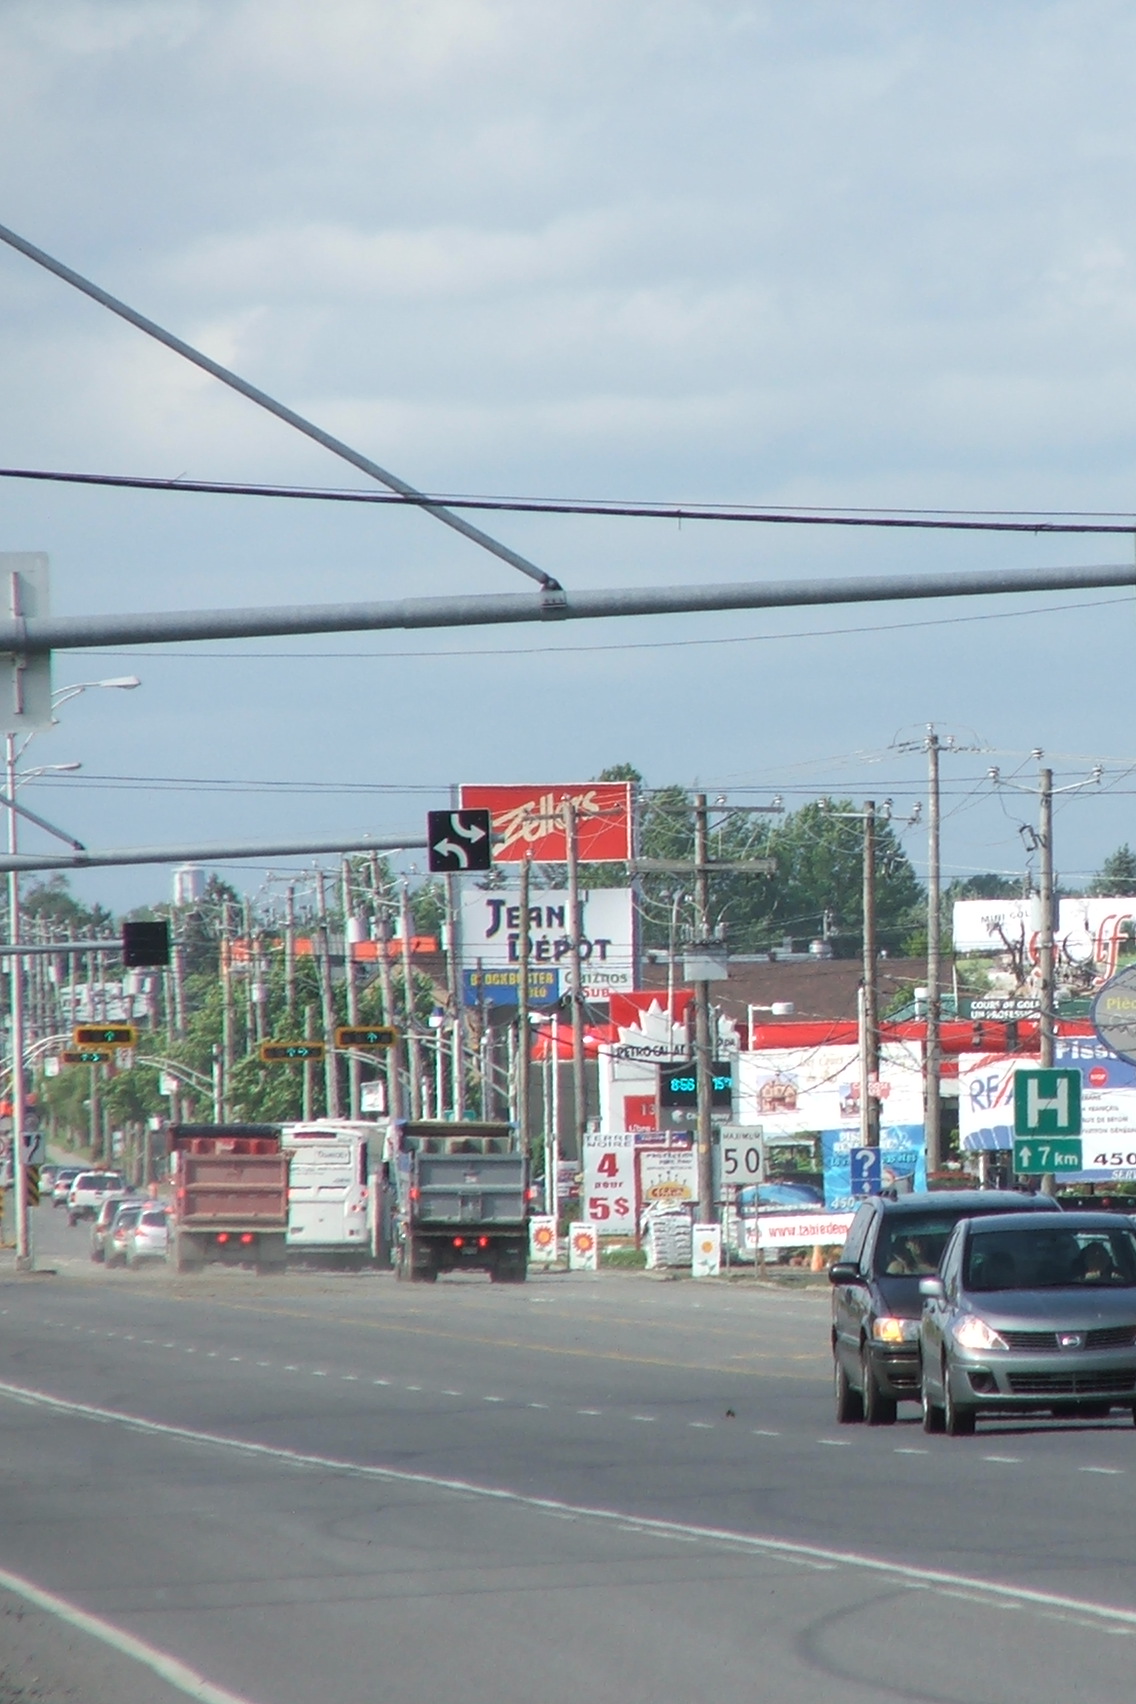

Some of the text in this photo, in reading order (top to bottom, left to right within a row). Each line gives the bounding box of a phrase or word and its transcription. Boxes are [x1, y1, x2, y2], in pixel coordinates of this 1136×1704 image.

[486, 899, 565, 938] JEAN
[1027, 1078, 1068, 1128] H
[597, 1153, 619, 1177] 4
[725, 1147, 760, 1175] 50
[1038, 1146, 1078, 1166] 7 km
